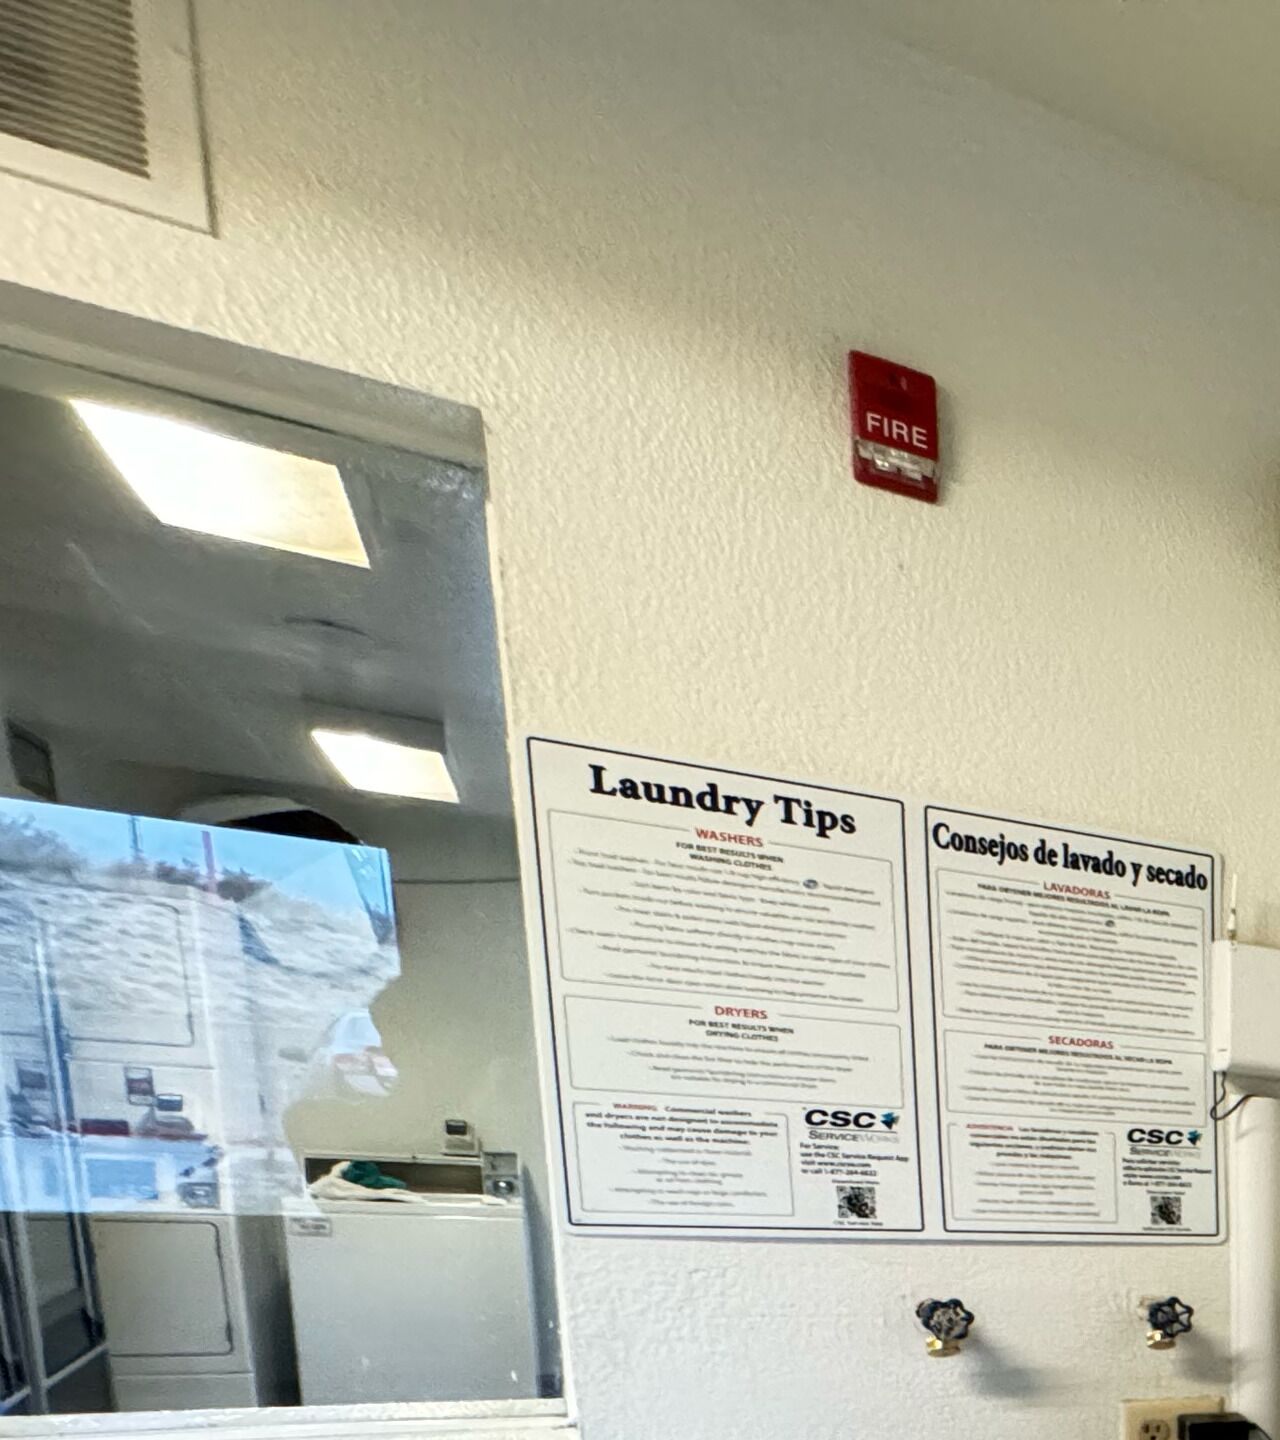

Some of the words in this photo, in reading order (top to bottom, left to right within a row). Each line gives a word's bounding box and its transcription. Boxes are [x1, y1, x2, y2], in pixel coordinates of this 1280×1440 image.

[866, 411, 928, 449] FIRE
[588, 764, 764, 827] Laundry
[773, 794, 857, 838] Tips
[694, 827, 764, 848] WASHERS
[675, 841, 694, 850] FOR
[696, 844, 718, 854] BEST
[719, 848, 756, 860] RESULTS
[757, 853, 784, 863] WHEN
[931, 822, 1030, 867] Consejos
[1033, 839, 1059, 867] de
[1062, 843, 1127, 878] lavado
[1130, 861, 1143, 887] y
[1146, 864, 1208, 891] secado
[733, 859, 772, 871] CLOTHES
[1043, 881, 1112, 900] LAVADORAS
[714, 1005, 768, 1020] DRYERS
[689, 1018, 706, 1028] FOR
[708, 1021, 729, 1029] BEST
[731, 1023, 767, 1032] RESULTS
[1048, 1035, 1115, 1050] SECADORAS
[805, 1109, 877, 1129] CSC
[1127, 1128, 1184, 1145] CSC
